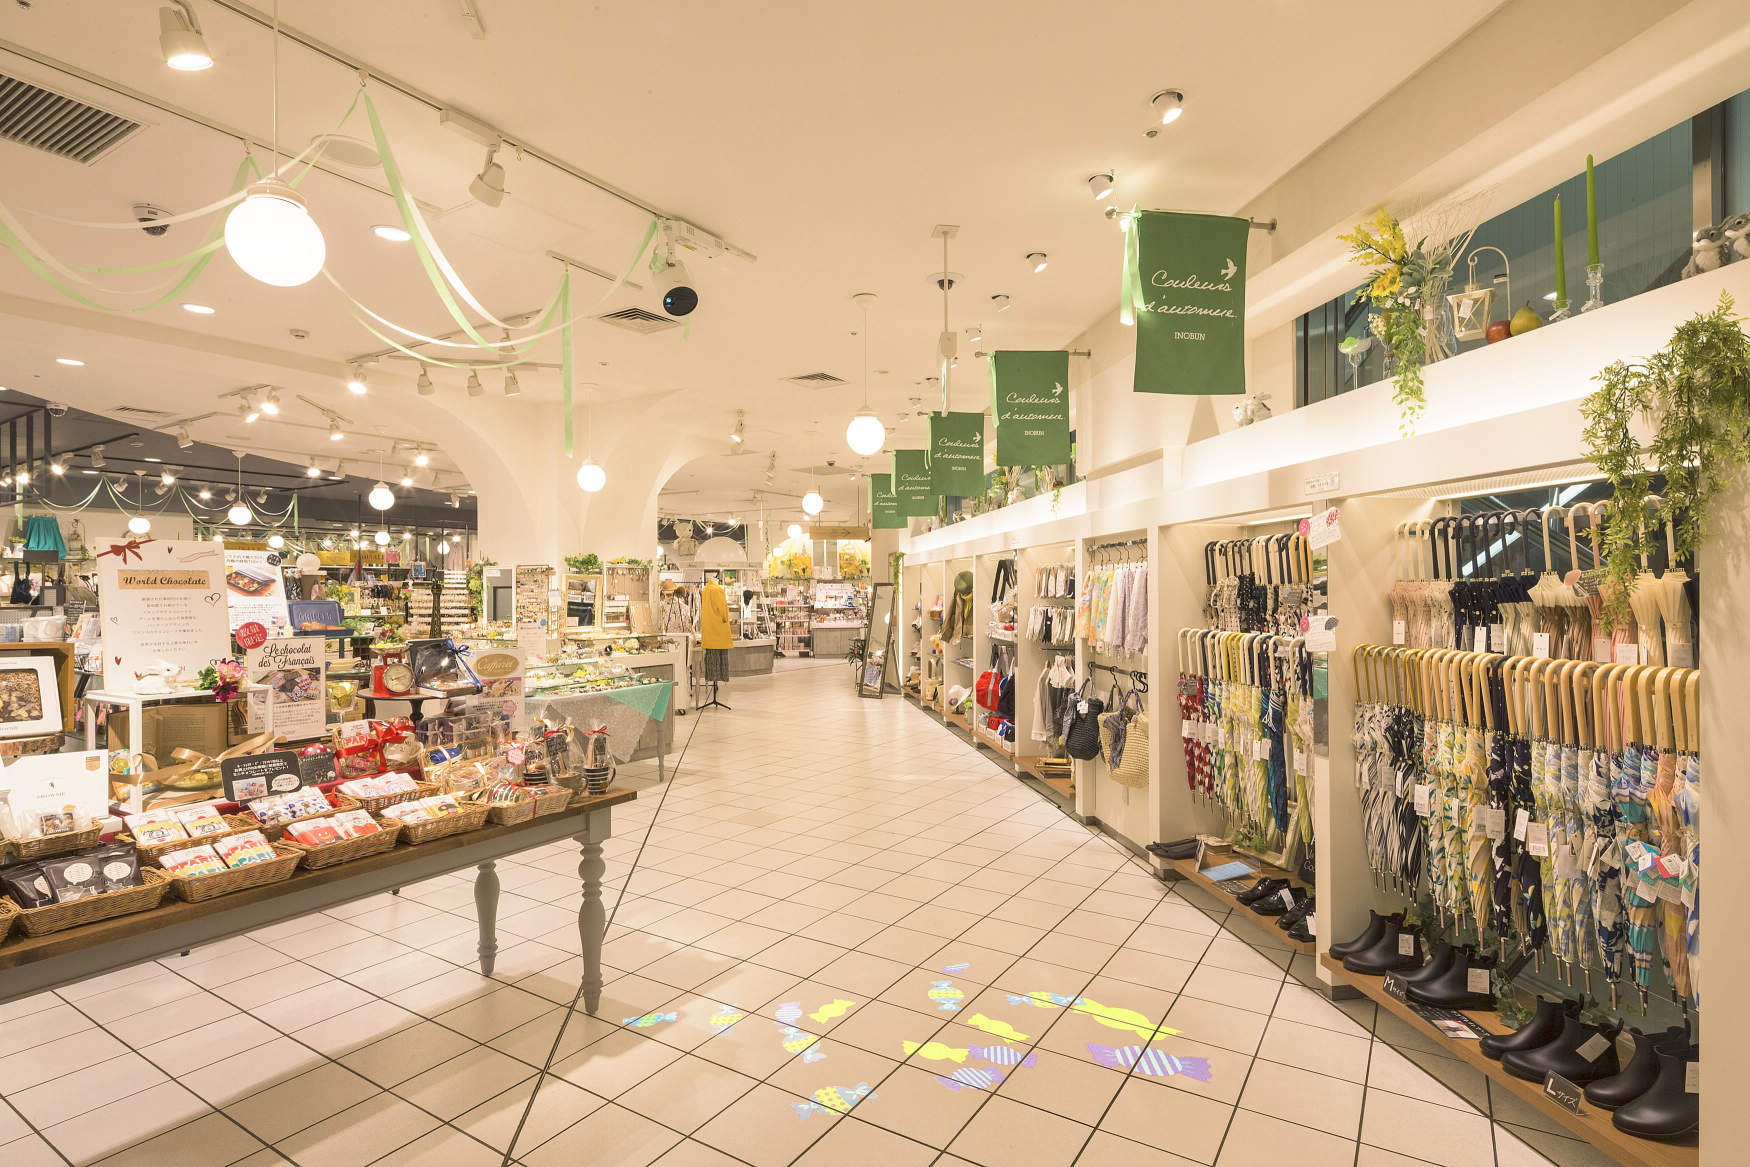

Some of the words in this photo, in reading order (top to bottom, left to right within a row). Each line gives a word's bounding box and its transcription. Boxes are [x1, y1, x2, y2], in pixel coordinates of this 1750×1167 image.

[1151, 269, 1232, 291] Couleurs
[1174, 331, 1206, 341] INOBUN
[1006, 391, 1061, 404] Couleurs
[123, 576, 157, 585] World
[160, 576, 206, 585] Chocolate
[264, 643, 279, 658] Le
[280, 643, 312, 655] chocolat
[258, 658, 271, 668] des
[273, 655, 315, 669] Français
